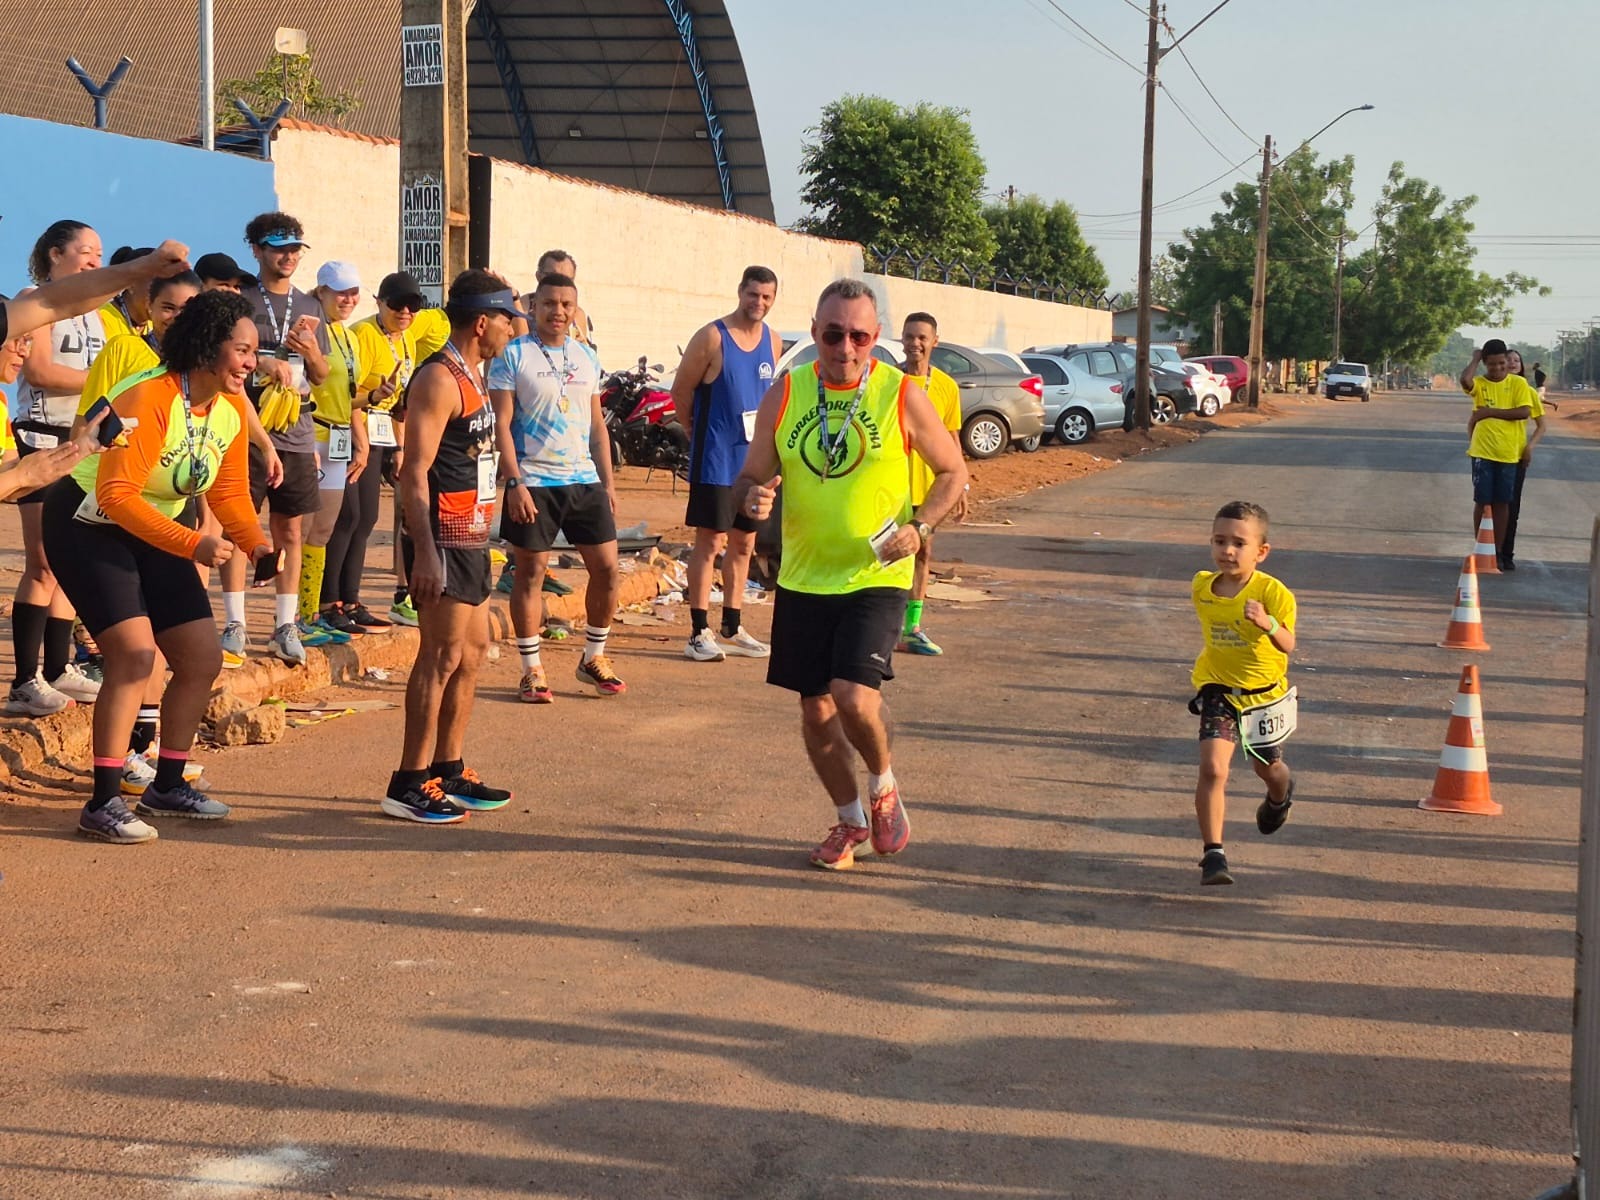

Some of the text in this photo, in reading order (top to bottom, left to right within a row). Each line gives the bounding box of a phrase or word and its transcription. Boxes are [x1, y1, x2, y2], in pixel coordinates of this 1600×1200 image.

[405, 42, 442, 68] AMOR
[404, 186, 441, 211] AMOR
[404, 242, 441, 266] AMOR
[787, 400, 882, 450] CORREORE ALPHA
[1258, 712, 1285, 736] 6378
[402, 789, 431, 809] FILA
